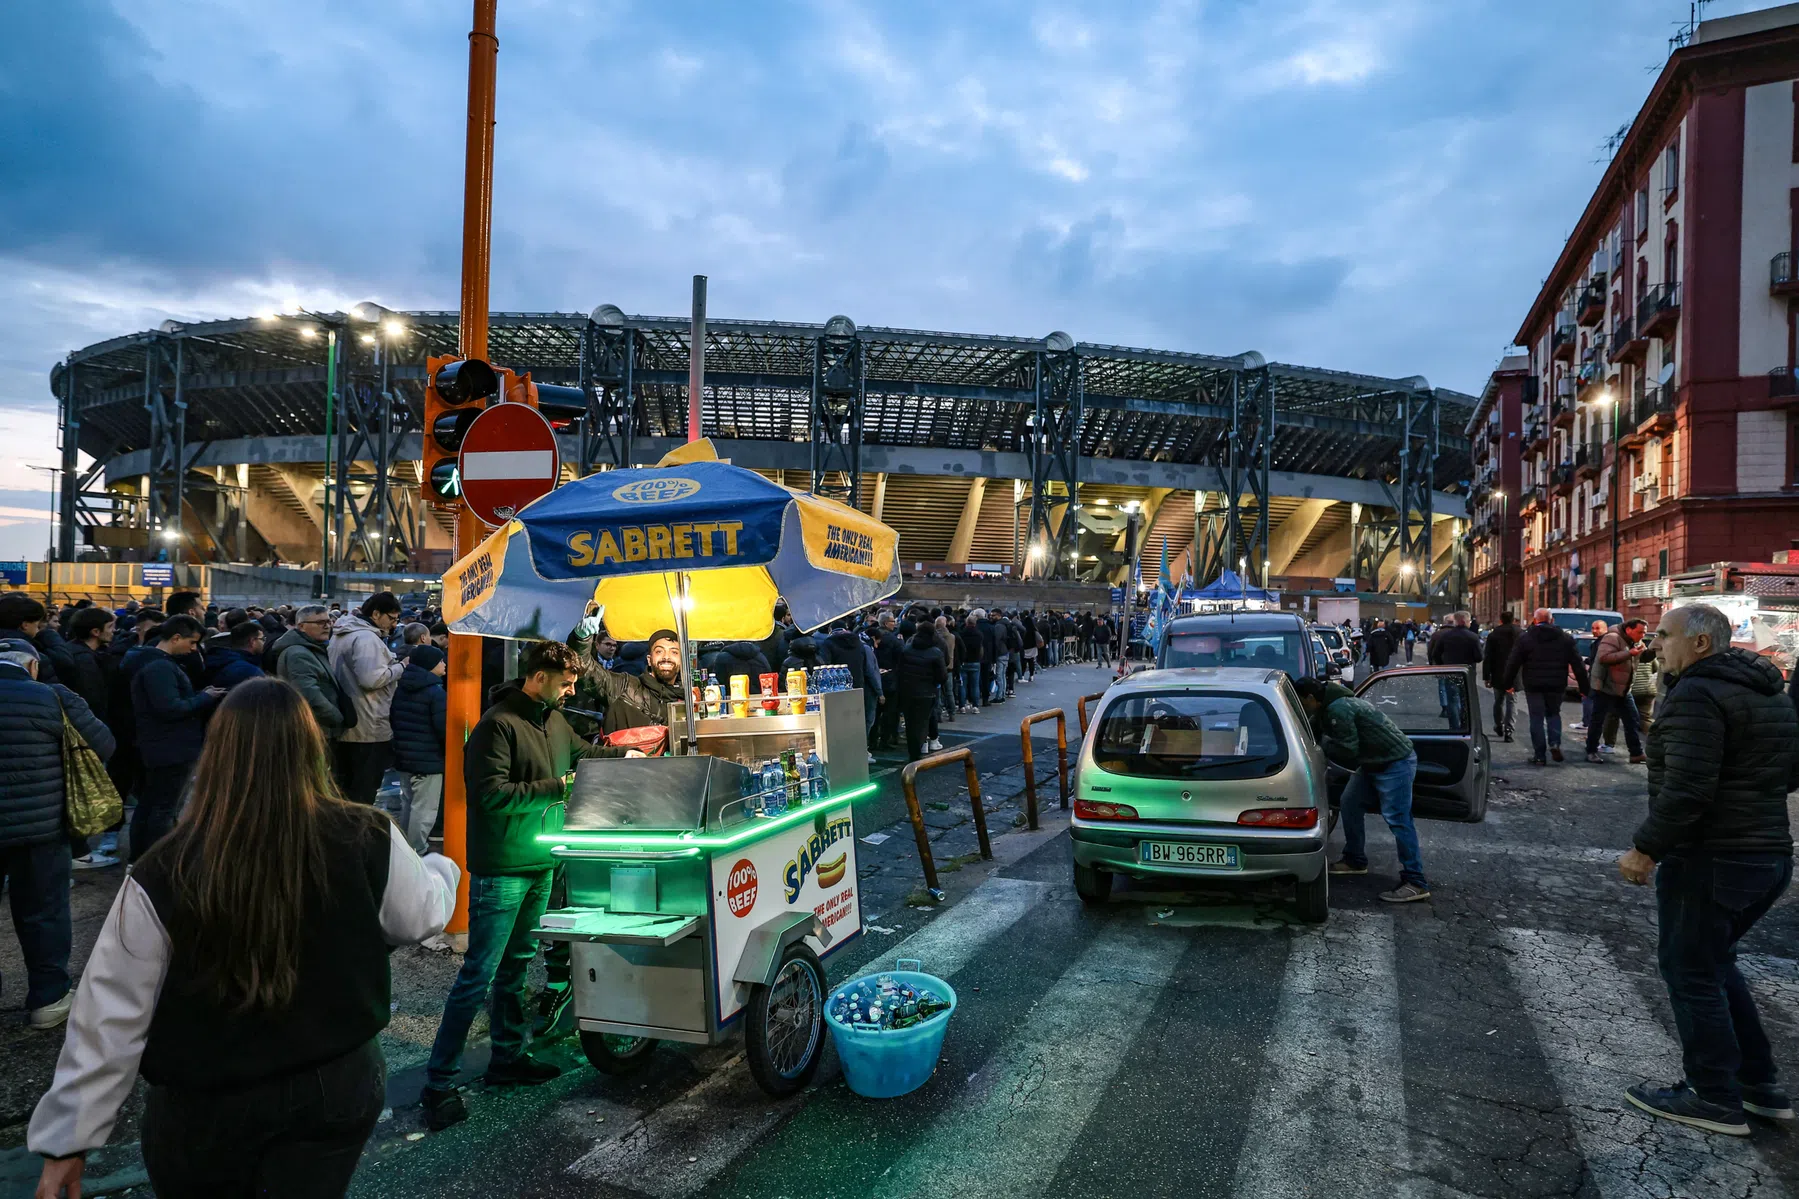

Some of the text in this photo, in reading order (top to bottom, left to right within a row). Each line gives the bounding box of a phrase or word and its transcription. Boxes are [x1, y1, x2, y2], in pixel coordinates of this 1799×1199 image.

[620, 487, 693, 500] BEEF
[630, 480, 688, 491] 100%
[566, 520, 744, 567] SABRETT
[827, 524, 873, 551] THE ONLY REAL
[824, 541, 873, 567] AMERICAN!!!
[783, 817, 852, 904] SABRETT
[729, 865, 757, 890] 100%
[729, 886, 757, 913] BEEF
[814, 887, 853, 917] THE ONLY REAL
[822, 902, 852, 928] MERICAN!!!
